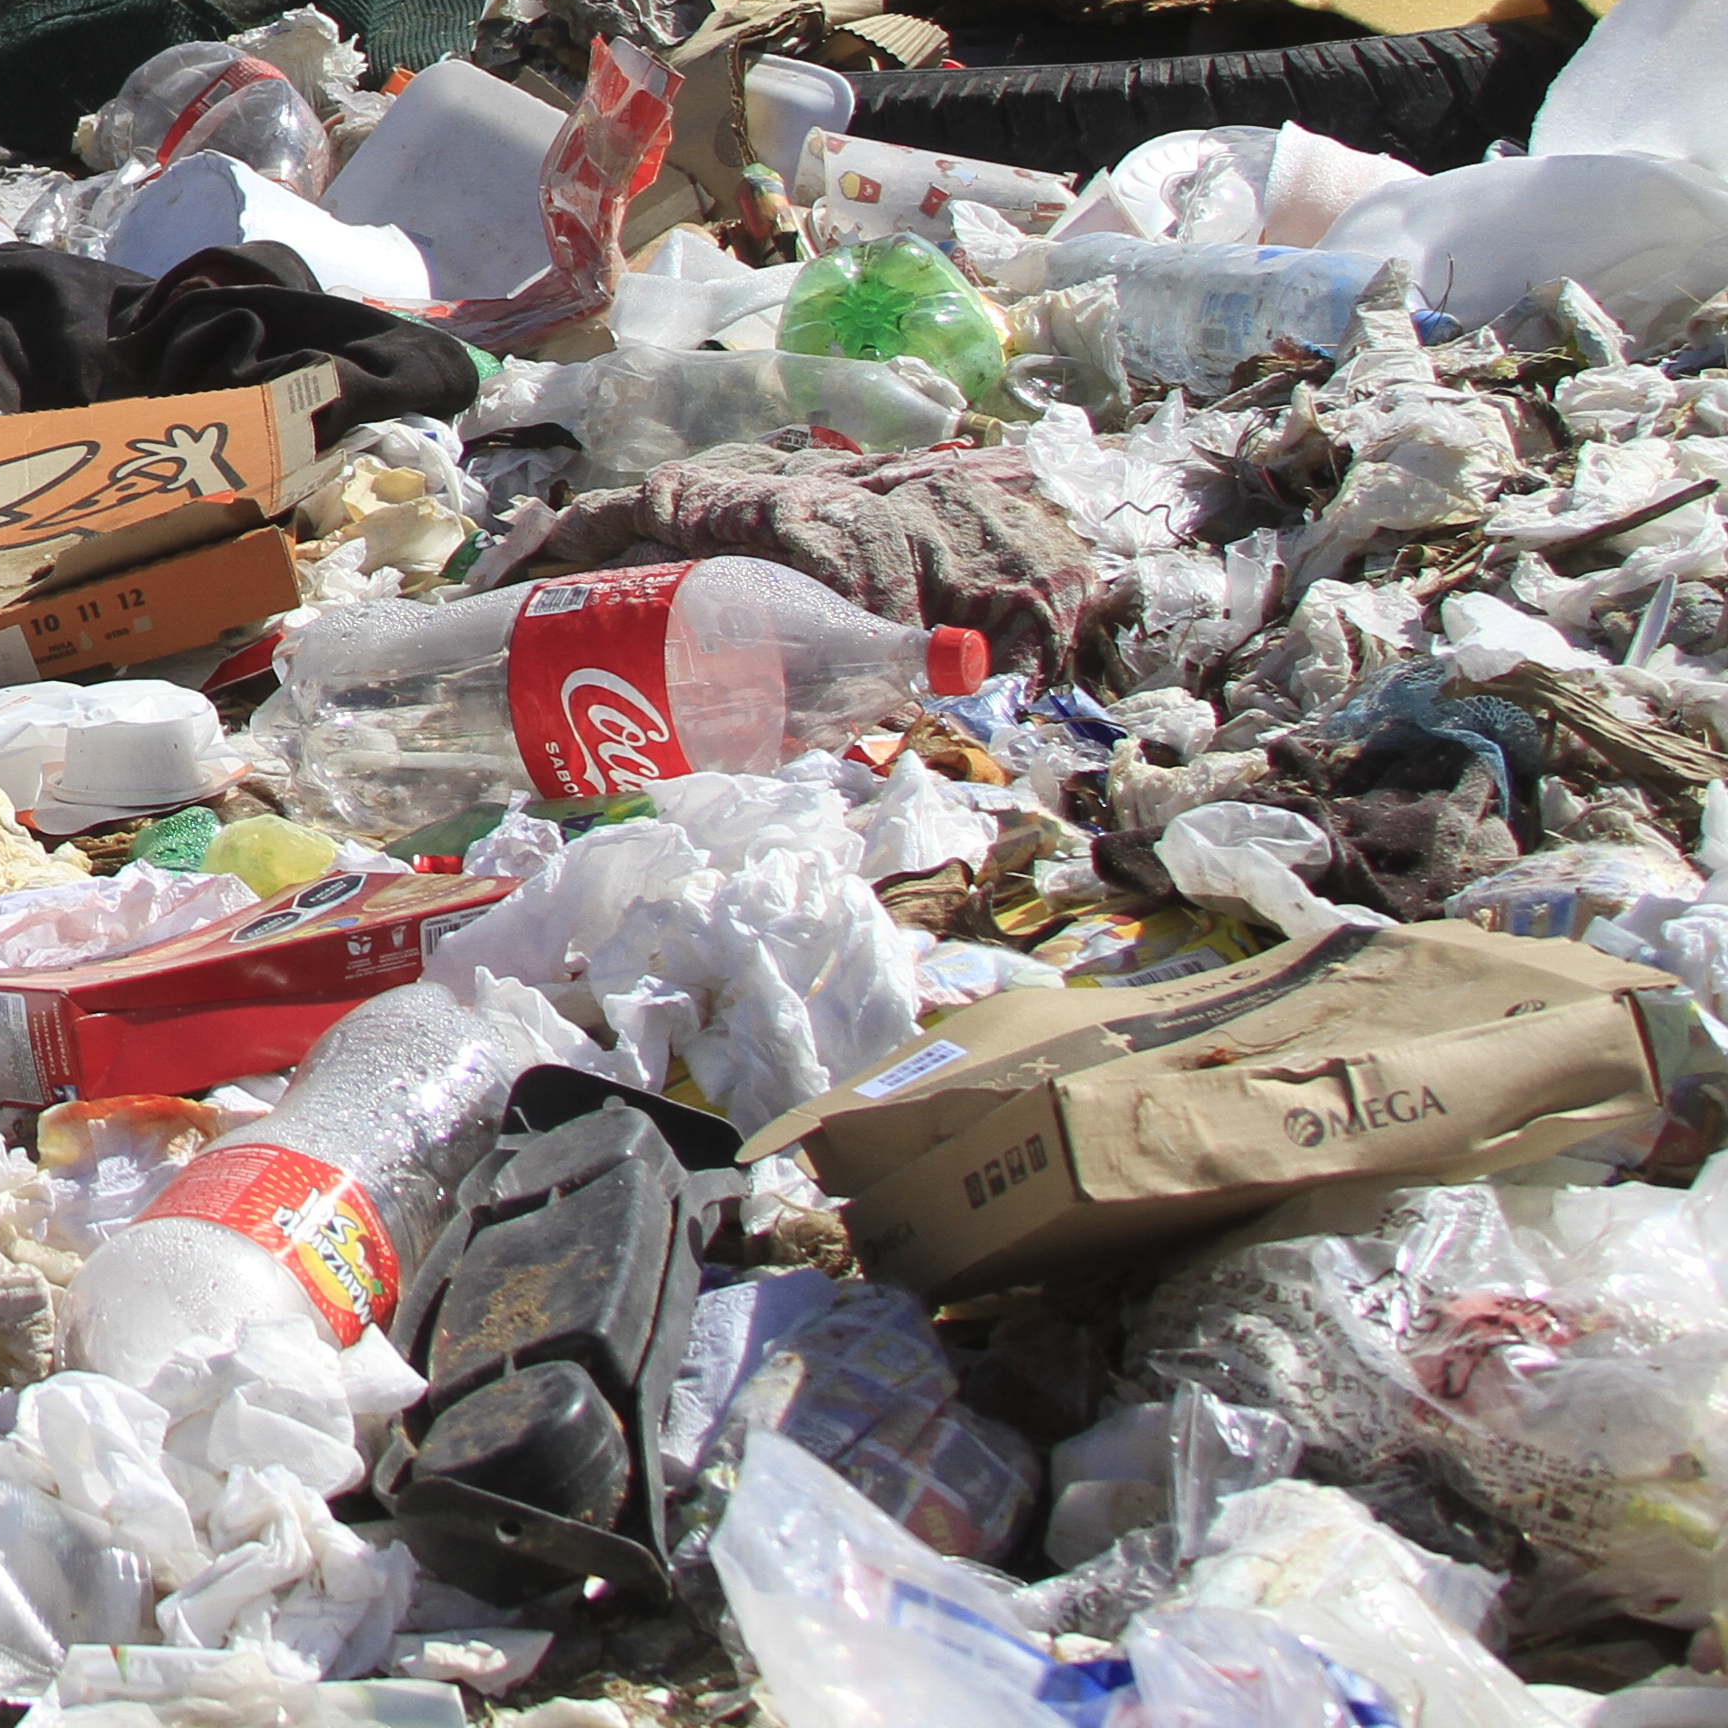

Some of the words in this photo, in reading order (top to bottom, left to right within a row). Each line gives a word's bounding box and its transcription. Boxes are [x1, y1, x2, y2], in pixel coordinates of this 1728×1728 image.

[30, 614, 61, 637] 10
[77, 601, 101, 624] 11
[118, 587, 146, 611] 12
[544, 741, 587, 799] SABO
